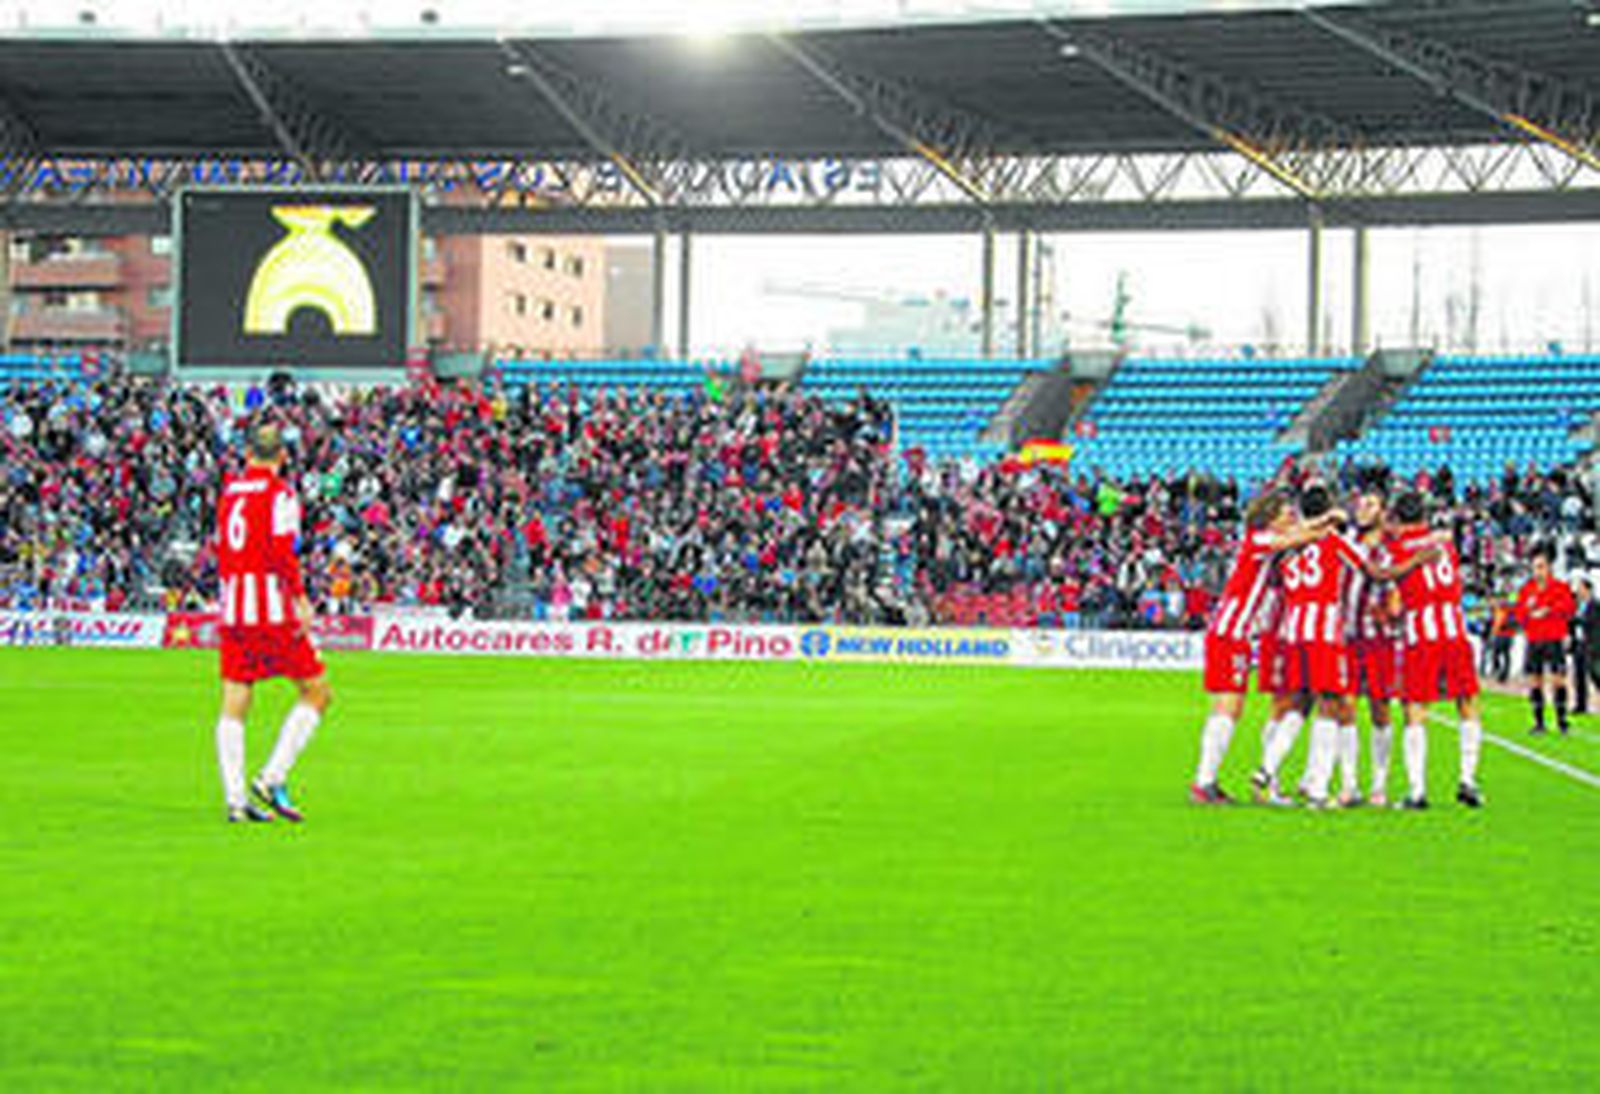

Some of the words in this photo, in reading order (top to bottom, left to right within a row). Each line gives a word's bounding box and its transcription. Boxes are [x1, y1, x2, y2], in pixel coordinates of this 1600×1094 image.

[228, 497, 246, 550] 6
[1284, 544, 1321, 590] 33
[379, 622, 572, 652] Autocares
[587, 626, 622, 653] R.
[707, 627, 793, 657] Pino
[836, 637, 893, 654] NEW
[896, 637, 1010, 659] HOLLAND
